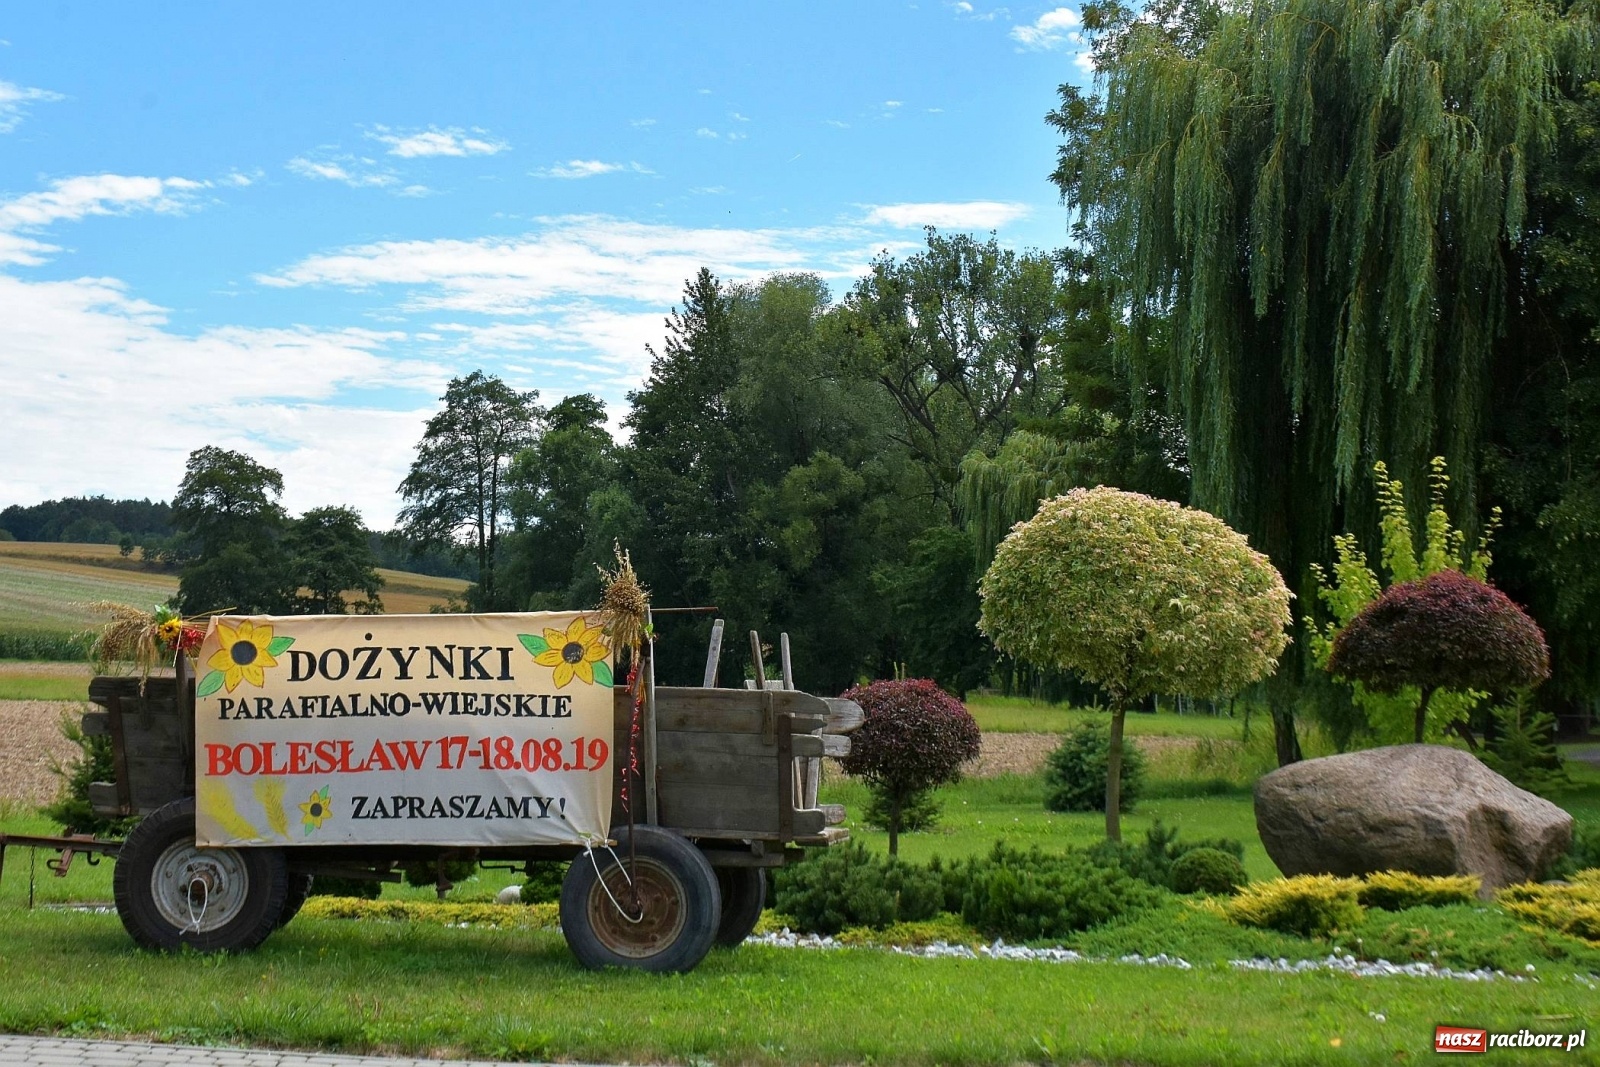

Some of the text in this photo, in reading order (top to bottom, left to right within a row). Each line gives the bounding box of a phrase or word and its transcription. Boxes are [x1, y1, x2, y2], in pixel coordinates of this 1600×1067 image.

[287, 632, 515, 682] DOŻYNKI
[218, 692, 572, 720] PARAFIALNO-WIEJSKIE
[204, 735, 609, 776] BOLESŁAW 17-18.08.19
[351, 795, 567, 820] ZAPRASZAMY!
